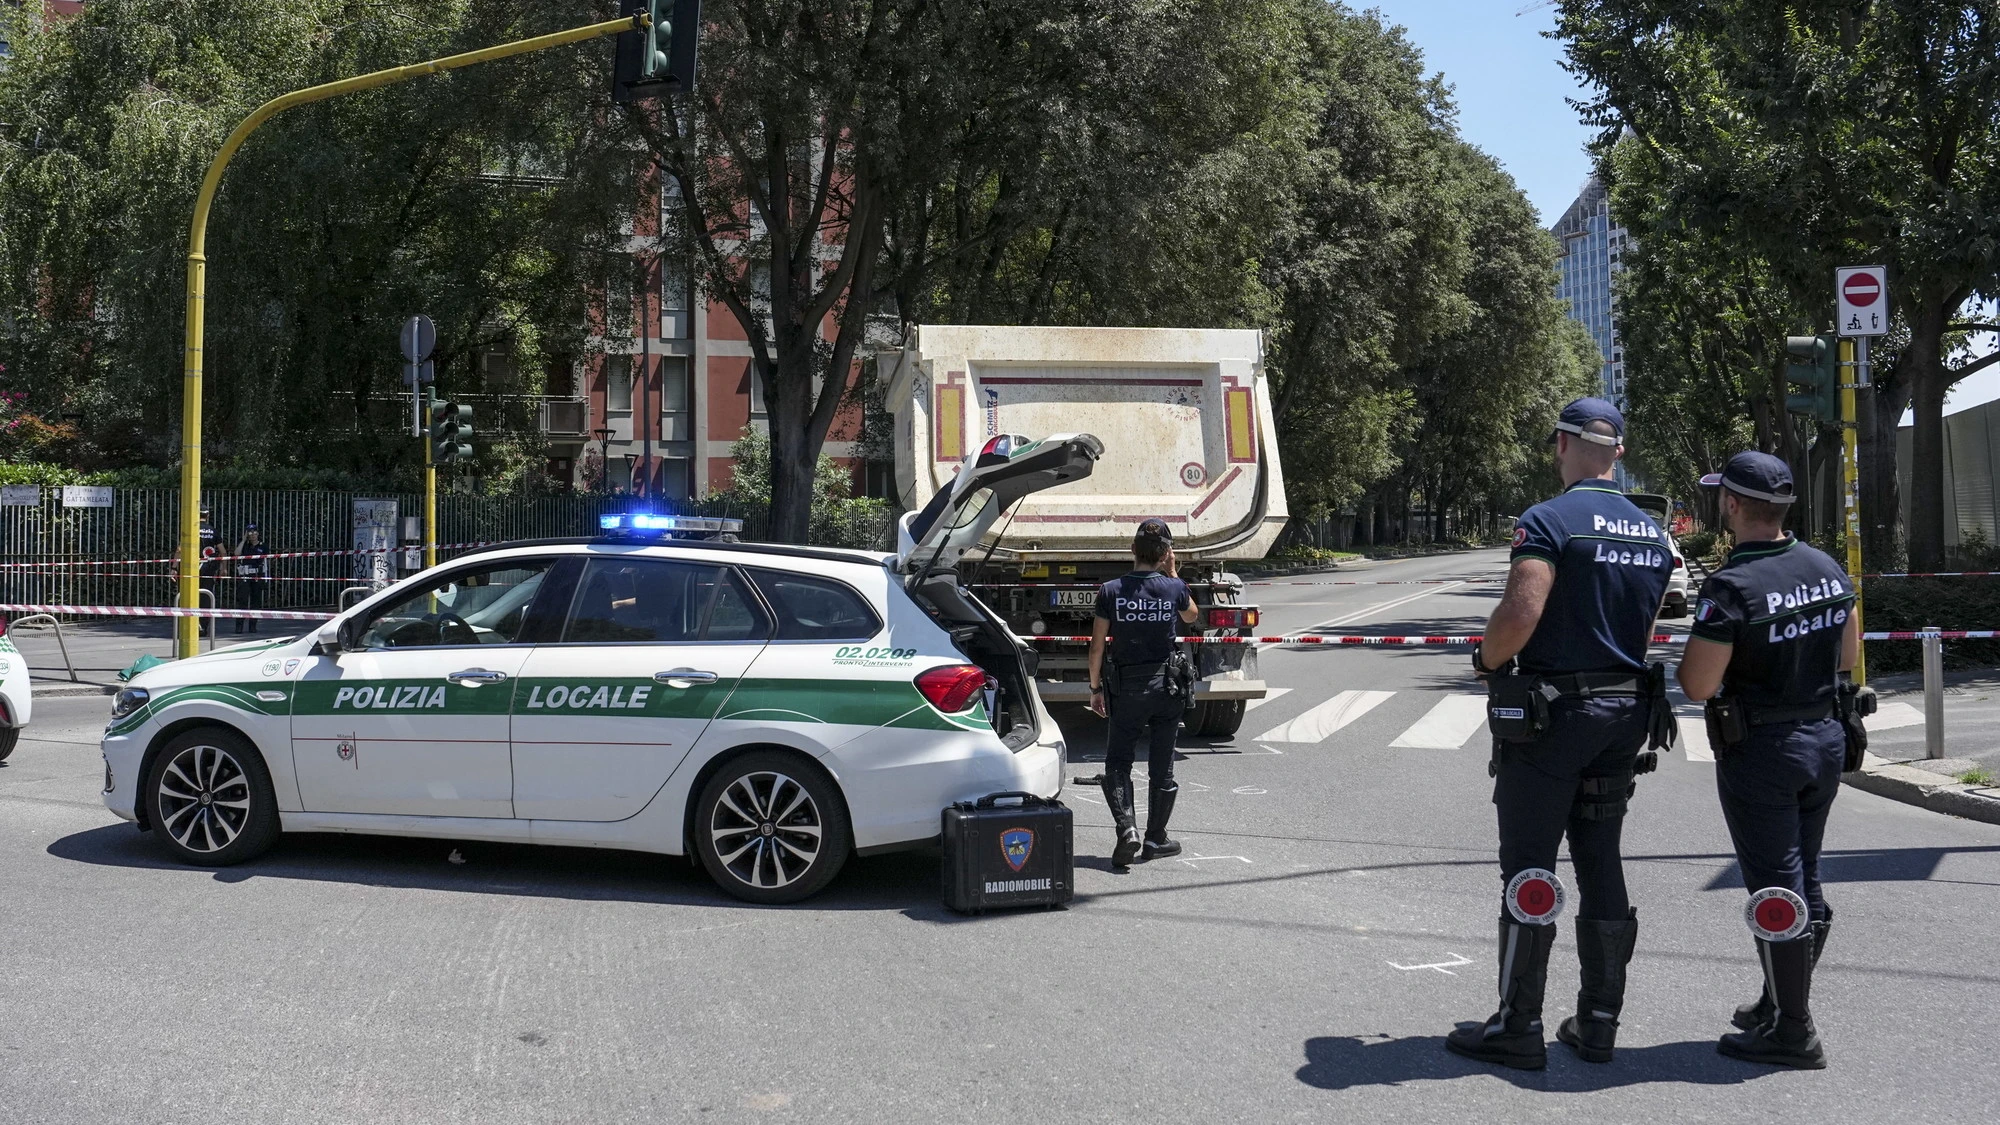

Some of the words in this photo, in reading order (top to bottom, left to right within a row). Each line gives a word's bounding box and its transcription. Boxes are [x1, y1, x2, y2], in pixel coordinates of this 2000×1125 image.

[1165, 386, 1186, 404] DIESEL
[1187, 469, 1200, 480] 80
[1593, 514, 1659, 538] Polizia
[1594, 544, 1662, 567] Locale
[1115, 597, 1172, 610] Polizia
[1766, 578, 1845, 614] Polizia
[1116, 610, 1172, 621] Locale
[1768, 608, 1847, 643] Locale
[835, 646, 917, 660] 02.0208
[265, 663, 280, 672] 1190
[333, 686, 446, 708] POLIZIA
[526, 685, 652, 708] LOCALE
[985, 878, 1051, 893] RADIOMOBILE
[1510, 872, 1531, 899] COMUNE
[1546, 875, 1563, 904] MILANO
[1747, 894, 1765, 921] COMUNE
[1781, 891, 1804, 916] MILANO
